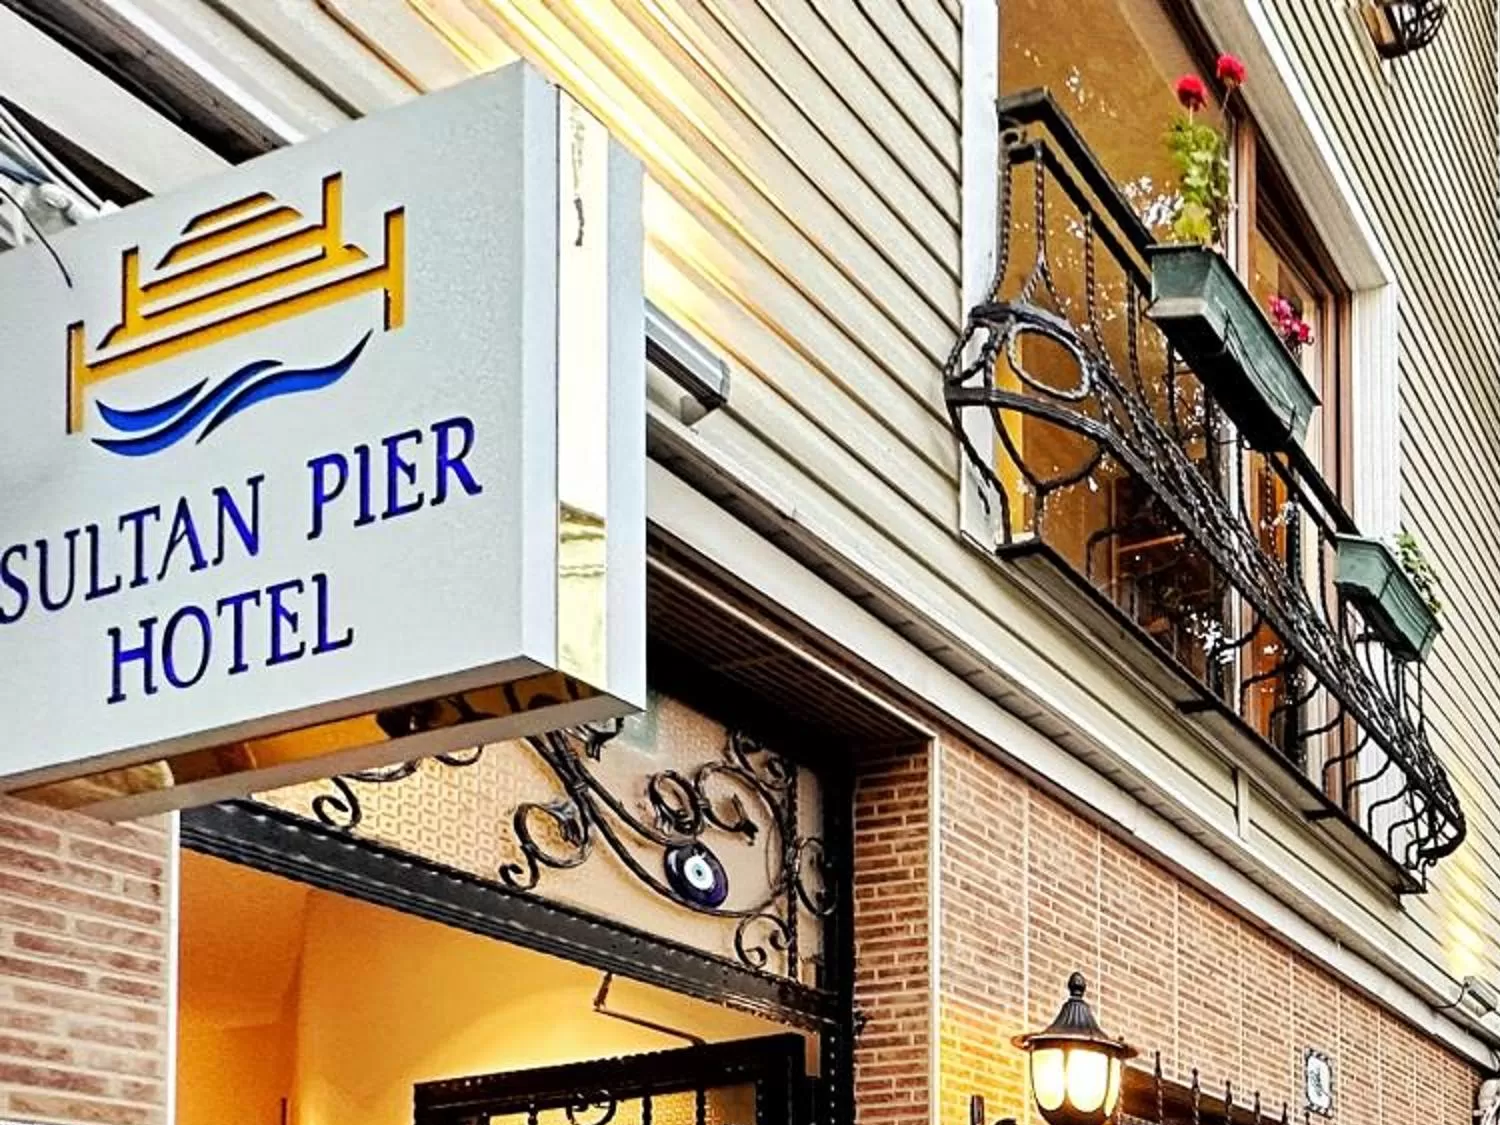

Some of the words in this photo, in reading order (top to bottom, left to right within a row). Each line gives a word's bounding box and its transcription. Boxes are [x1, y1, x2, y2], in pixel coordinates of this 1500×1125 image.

[0, 474, 265, 624] SULTAN
[306, 416, 483, 540] PIER
[106, 573, 354, 704] HOTEL
